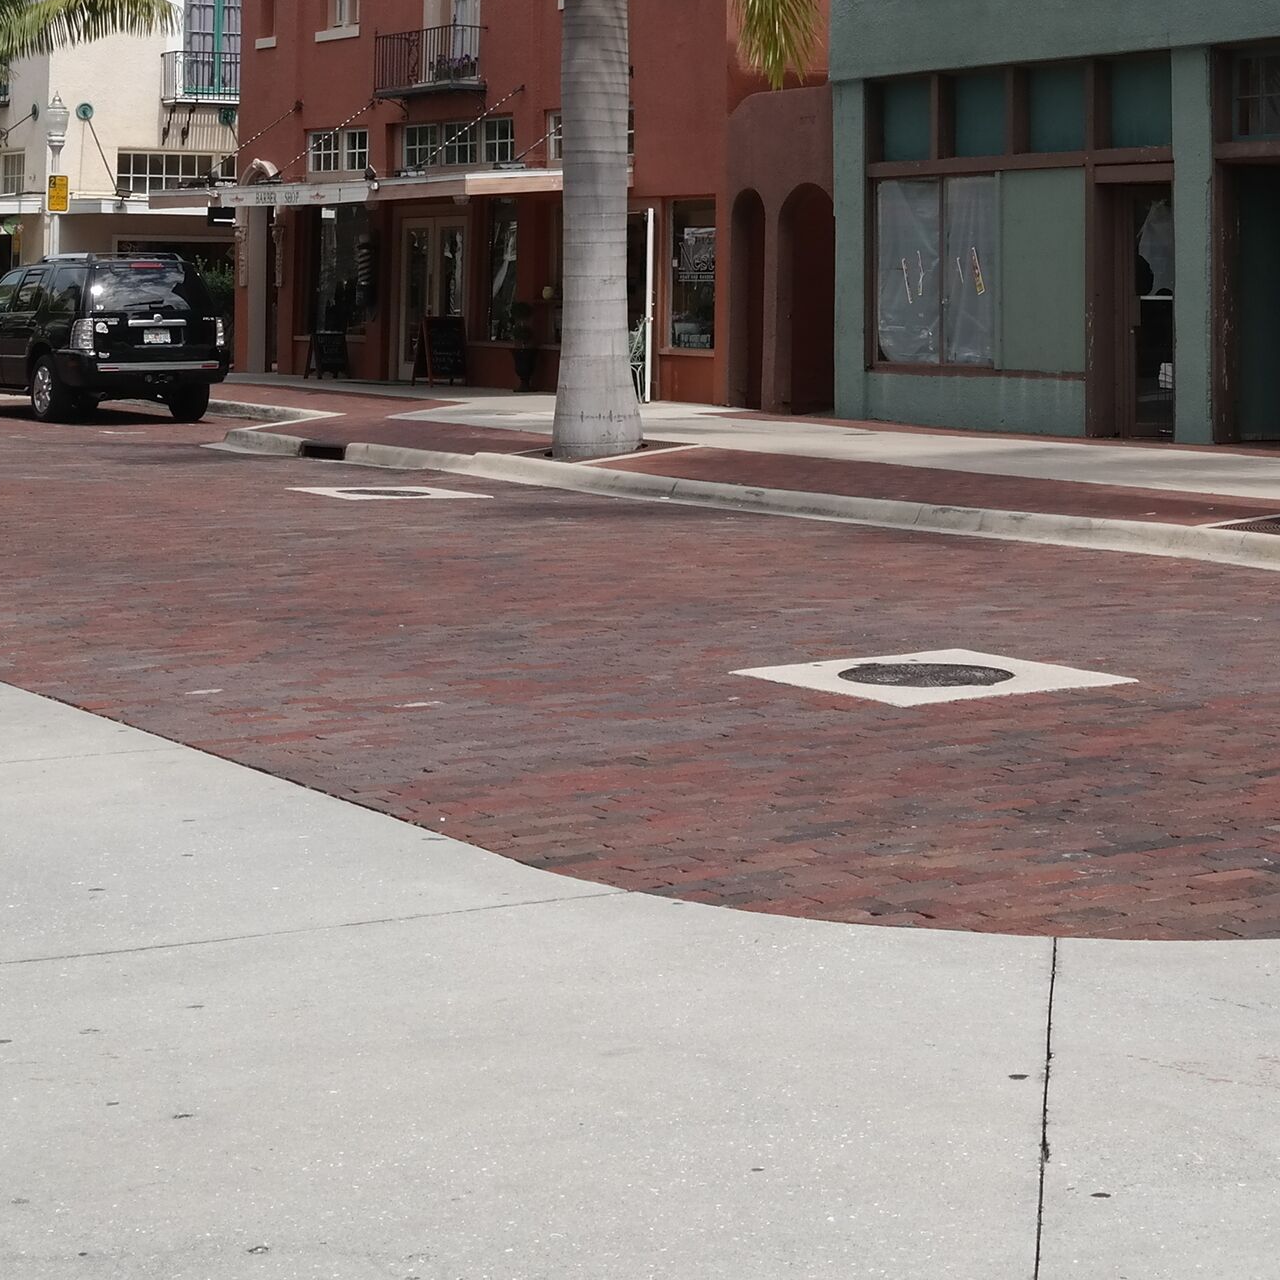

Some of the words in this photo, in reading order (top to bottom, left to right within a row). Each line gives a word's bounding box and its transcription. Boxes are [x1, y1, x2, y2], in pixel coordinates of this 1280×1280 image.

[255, 191, 277, 205] BARBER
[284, 191, 300, 204] SHOP
[678, 242, 715, 271] Nest
